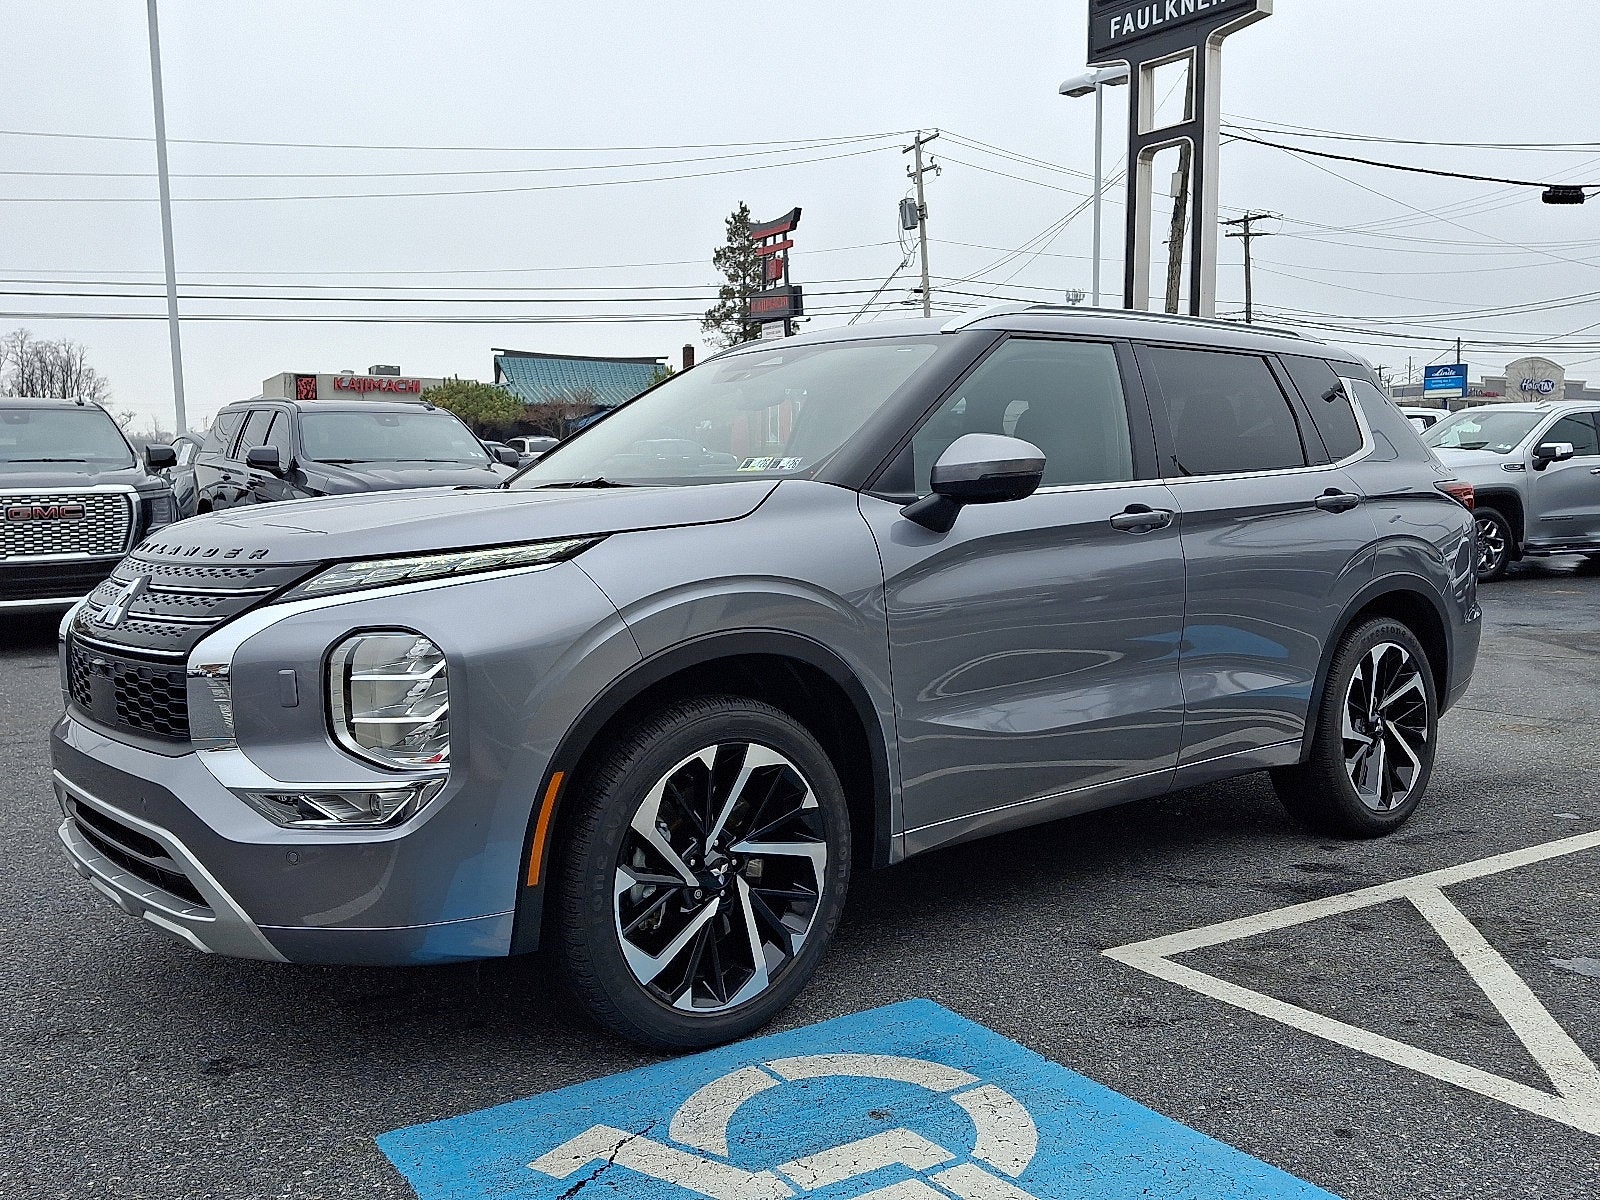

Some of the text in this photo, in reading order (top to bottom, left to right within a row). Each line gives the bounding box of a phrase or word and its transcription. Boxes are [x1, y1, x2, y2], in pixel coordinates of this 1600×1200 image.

[1109, 0, 1227, 39] FAULKN
[333, 376, 421, 394] KAJIMACHI
[7, 505, 83, 521] GMC
[134, 541, 270, 560] UTLANDER
